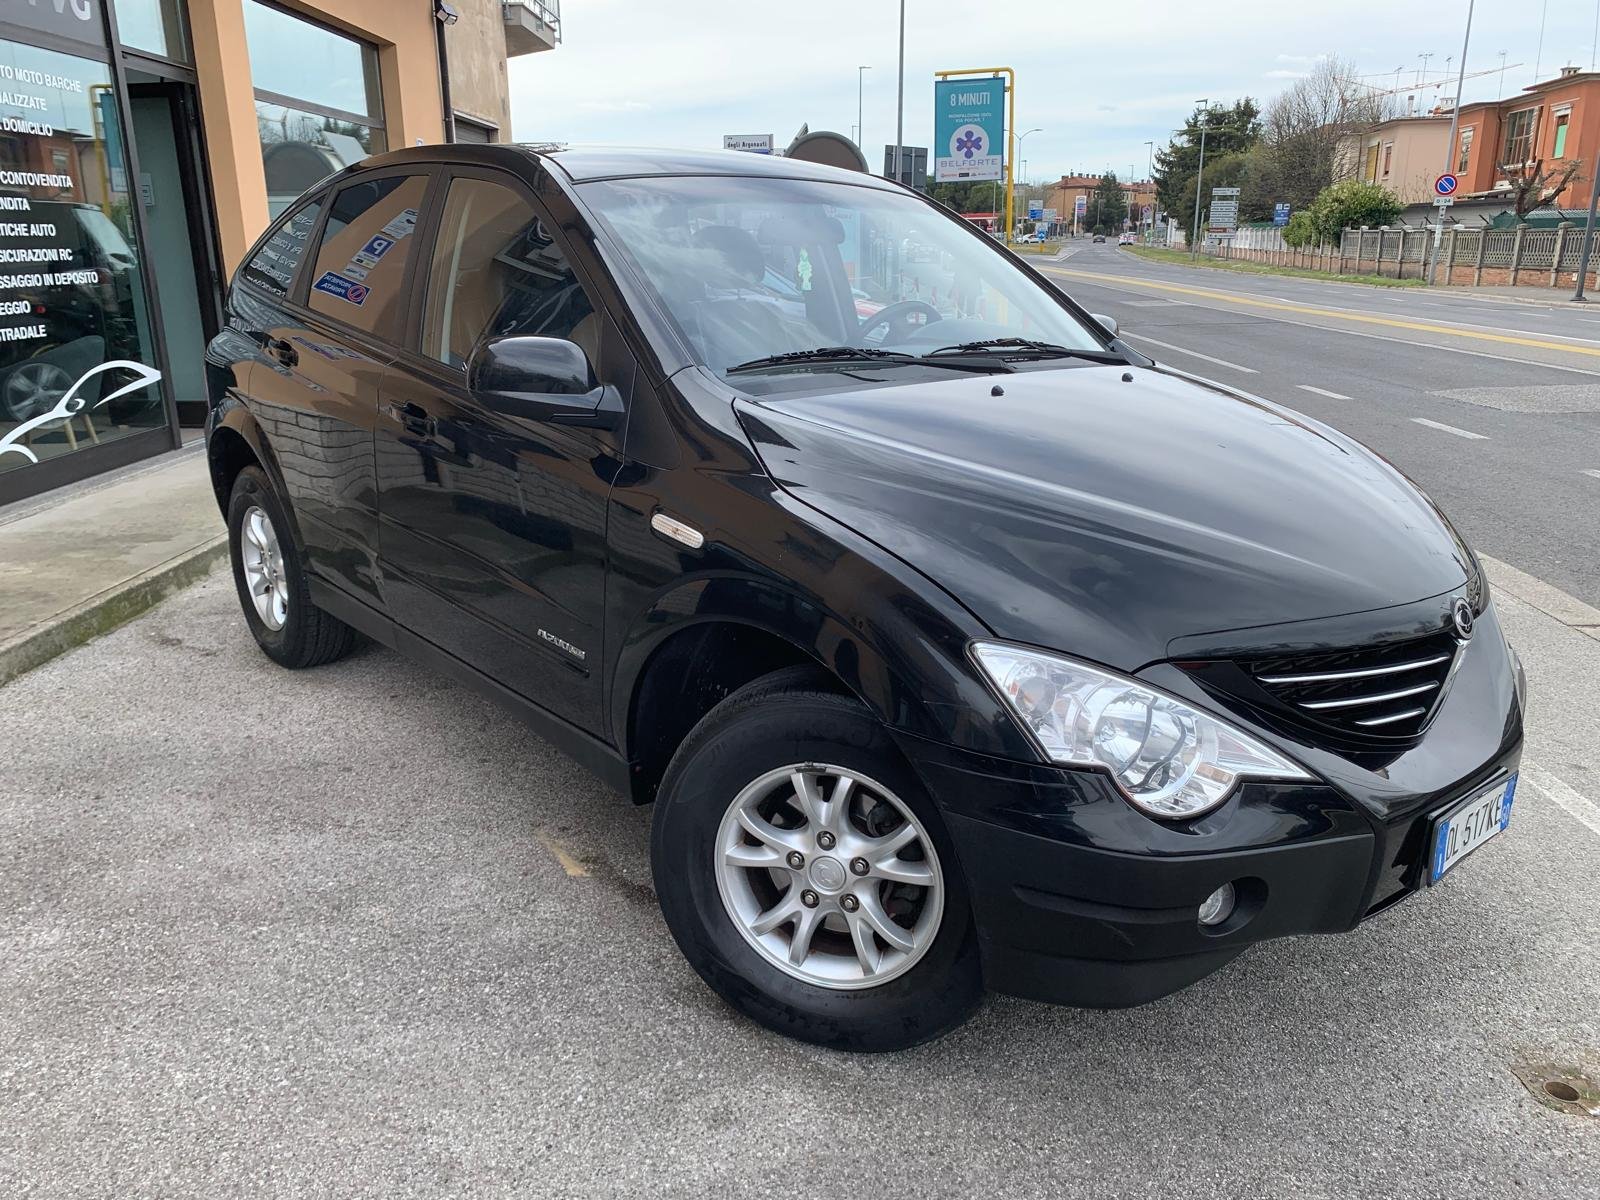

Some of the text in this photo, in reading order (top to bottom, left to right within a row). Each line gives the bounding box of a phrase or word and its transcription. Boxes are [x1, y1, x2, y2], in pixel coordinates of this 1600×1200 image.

[14, 68, 43, 85] MOTO
[45, 75, 83, 93] BARCHE
[0, 91, 47, 111] ALIZZATE
[950, 92, 991, 107] 8 MINUTI
[3, 117, 53, 136] DOMICILIO
[727, 141, 740, 149] degli
[940, 158, 998, 168] BELFORTE
[0, 170, 73, 188] CONTOVENDITA
[30, 223, 56, 236] AUTO
[60, 248, 73, 261] RC
[43, 273, 53, 286] IN
[55, 271, 99, 285] DEPOSITO
[1445, 823, 1459, 861] DL
[1463, 793, 1503, 846] 517KE
